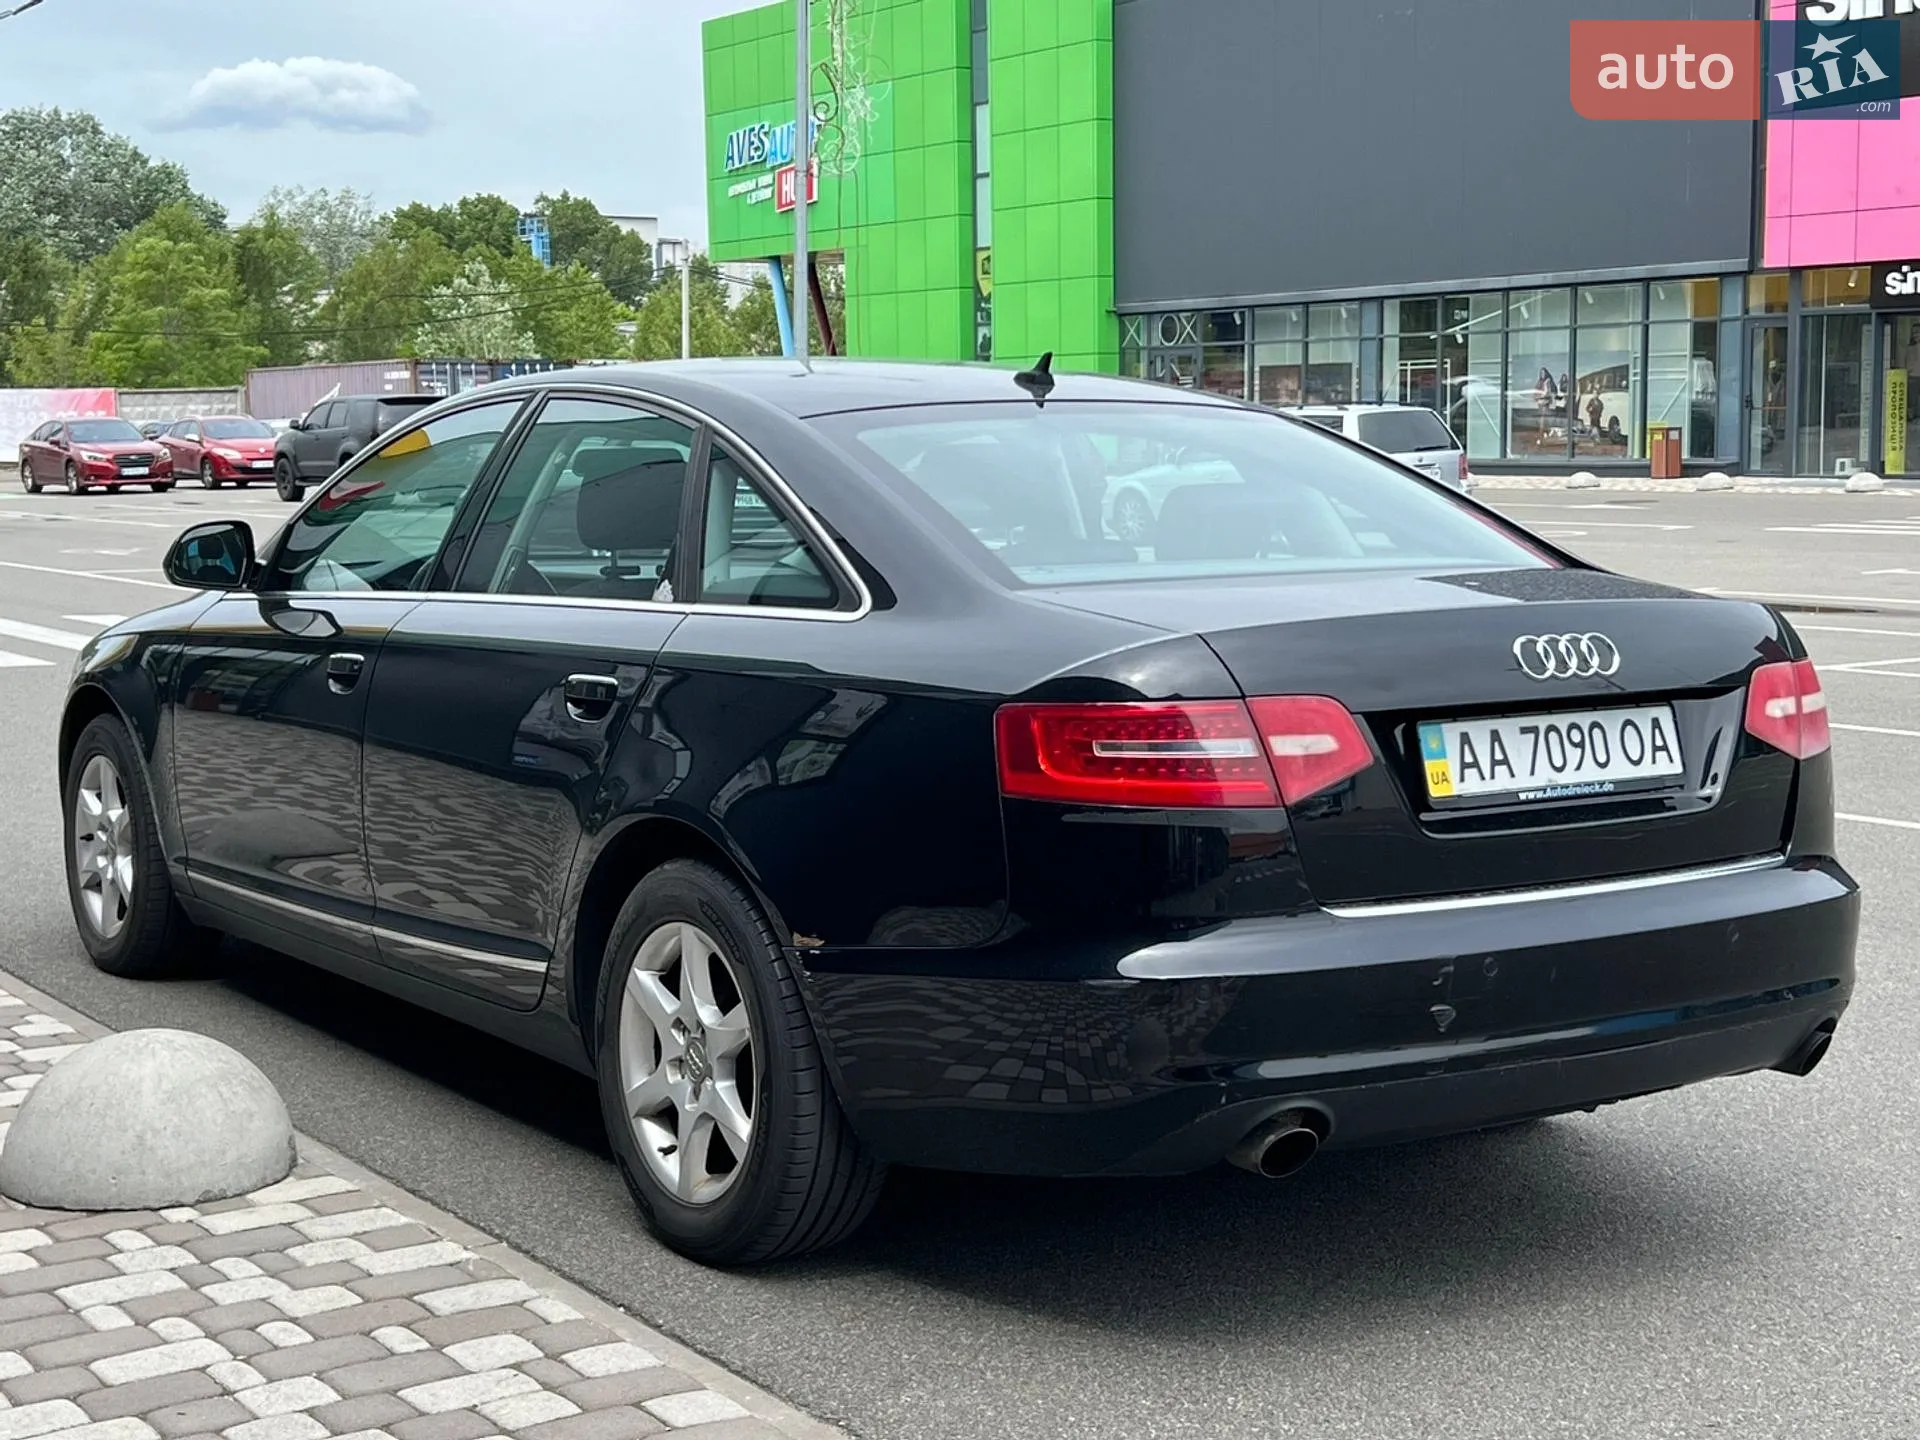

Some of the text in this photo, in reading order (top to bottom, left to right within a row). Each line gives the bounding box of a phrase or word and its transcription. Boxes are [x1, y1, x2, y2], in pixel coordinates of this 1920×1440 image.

[1458, 716, 1674, 783] AA 7090 OA
[1430, 770, 1450, 786] UA
